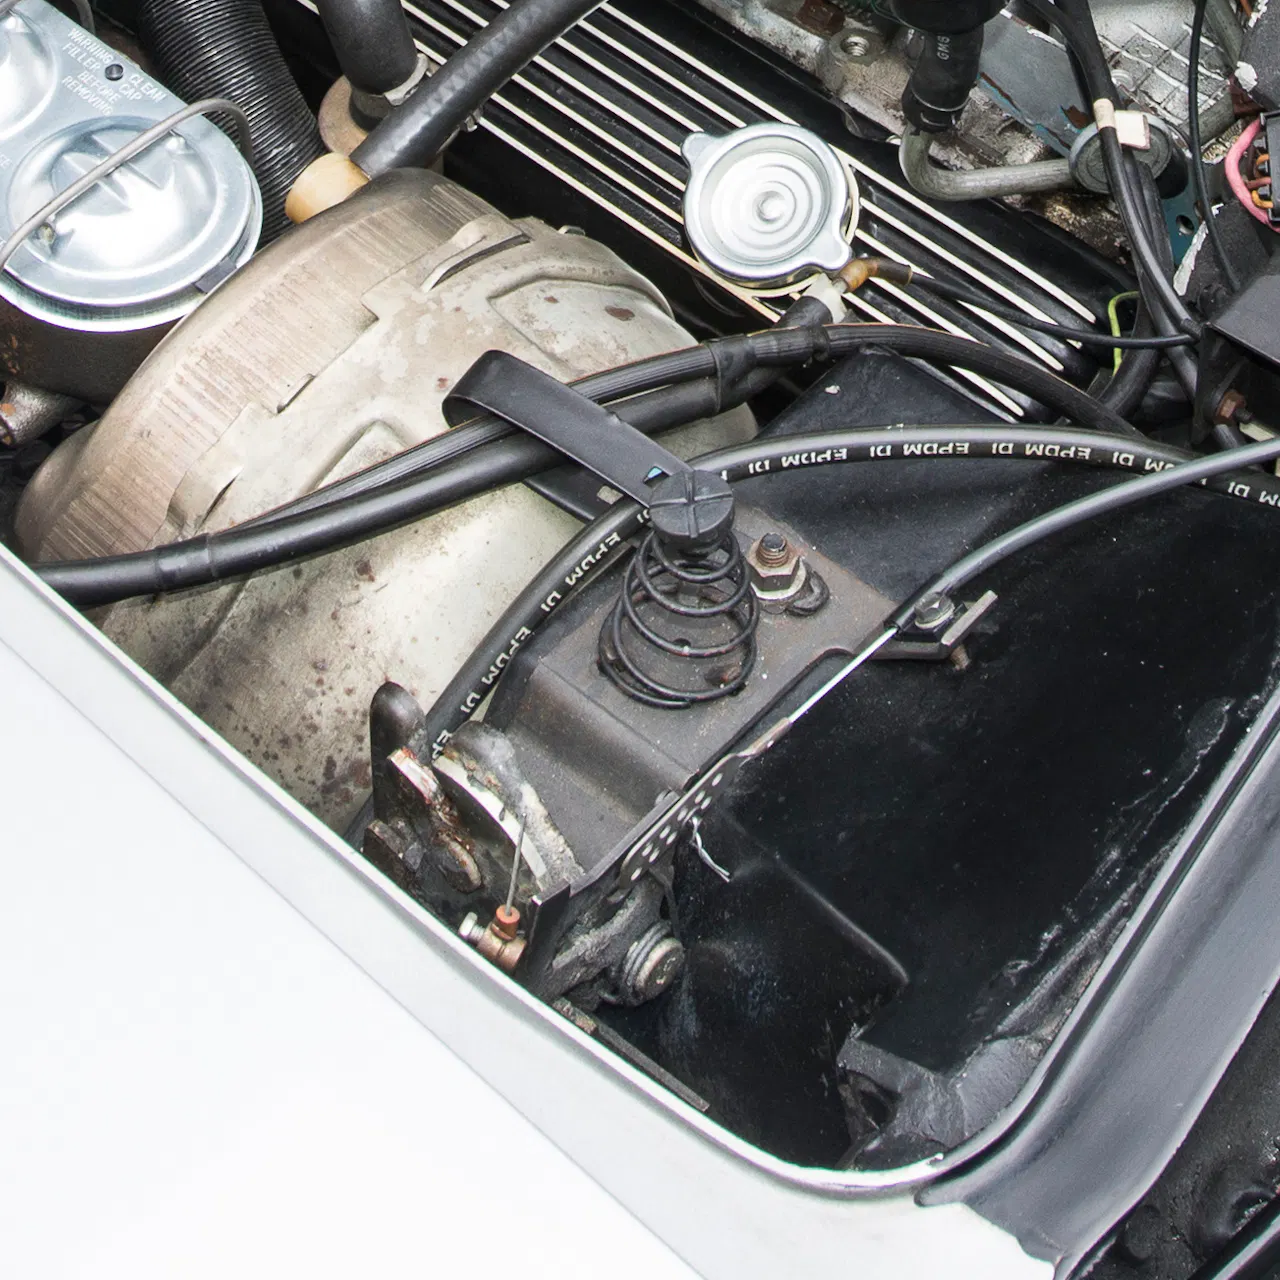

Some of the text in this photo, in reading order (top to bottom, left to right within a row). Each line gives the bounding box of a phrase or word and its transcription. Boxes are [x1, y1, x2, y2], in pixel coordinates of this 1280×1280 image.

[61, 42, 142, 101] FILLER CAP
[67, 27, 167, 103] WARNING CLEAN
[62, 75, 114, 116] REMOVING
[77, 70, 121, 105] BEFORE
[781, 447, 848, 468] EPDM
[903, 442, 970, 455] EPDM
[1024, 443, 1092, 460] EPDM
[565, 531, 621, 587] EPDM
[481, 625, 532, 686] EPDM
